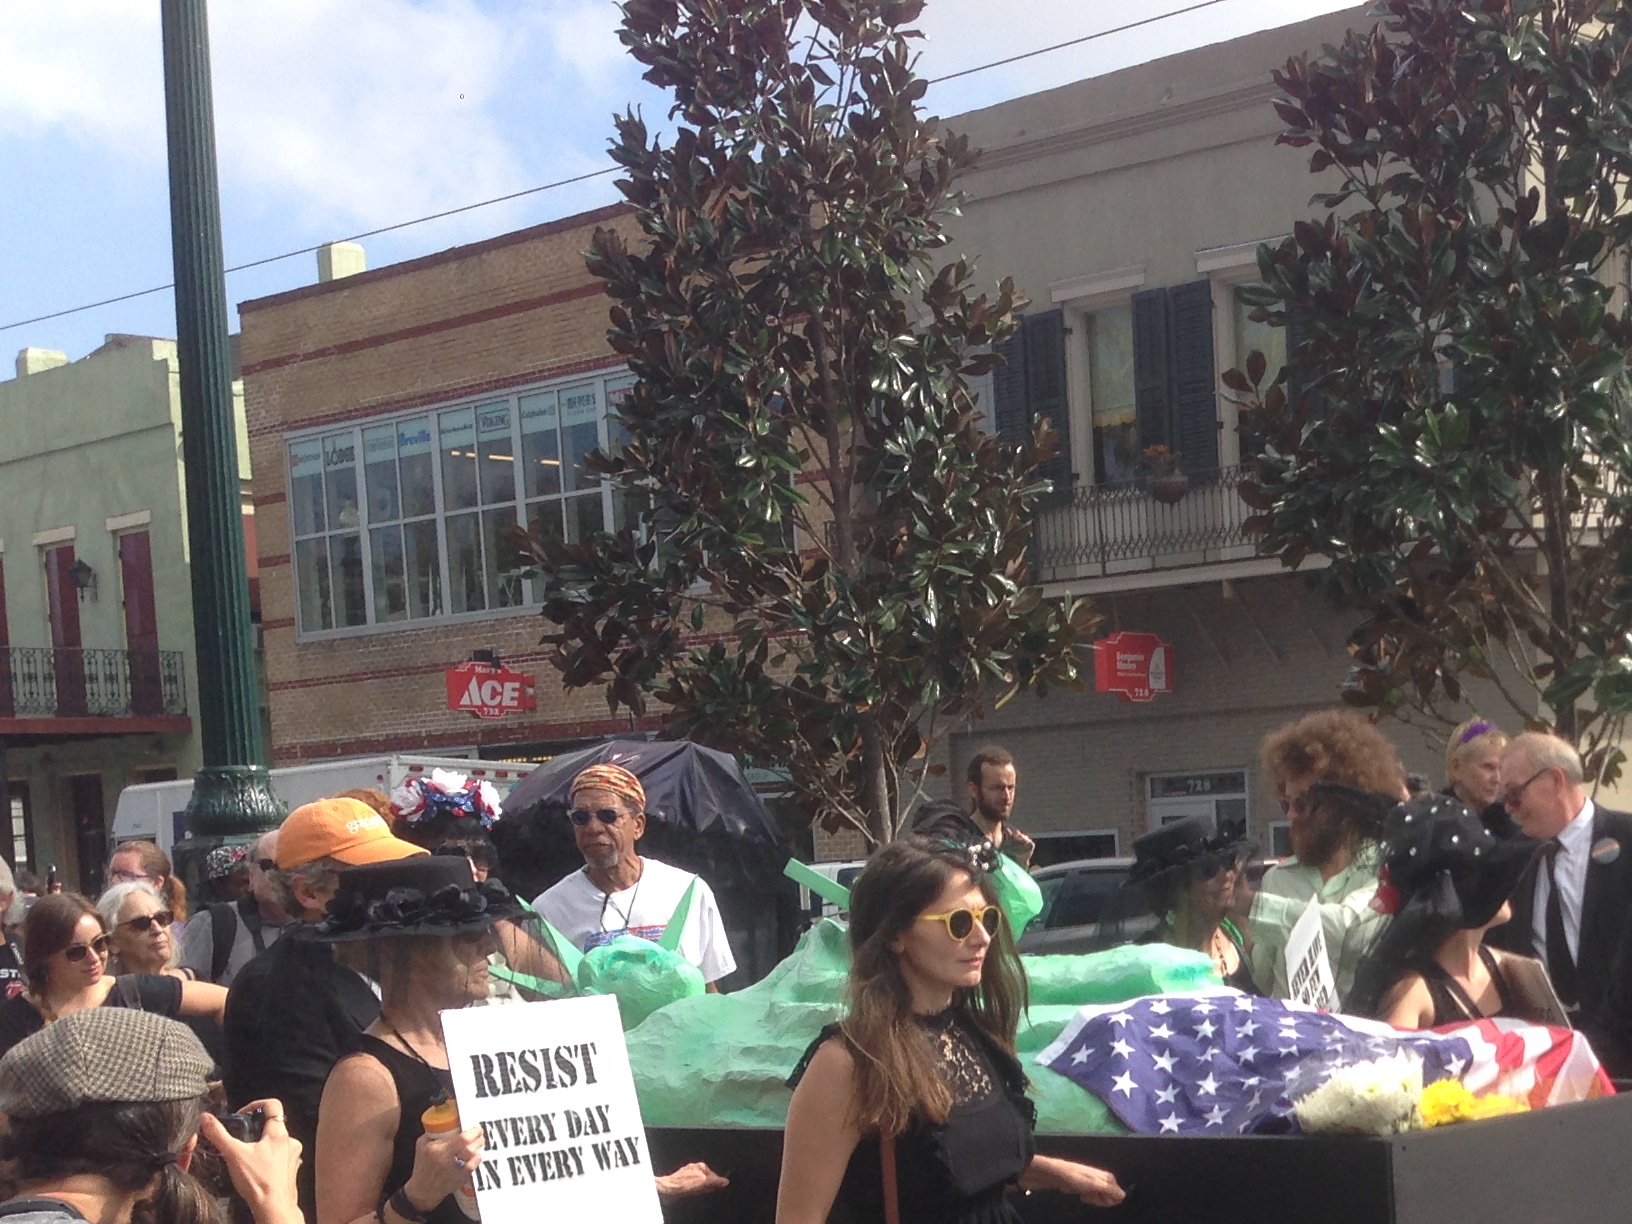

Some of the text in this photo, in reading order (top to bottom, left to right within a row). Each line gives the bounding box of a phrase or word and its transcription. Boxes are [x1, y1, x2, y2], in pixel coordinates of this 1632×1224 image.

[460, 675, 520, 707] ACE
[475, 665, 502, 675] Marys
[469, 1042, 598, 1099] RESIST
[479, 1104, 612, 1152] EVERY DAY
[474, 1136, 641, 1192] IN EVERY WAY
